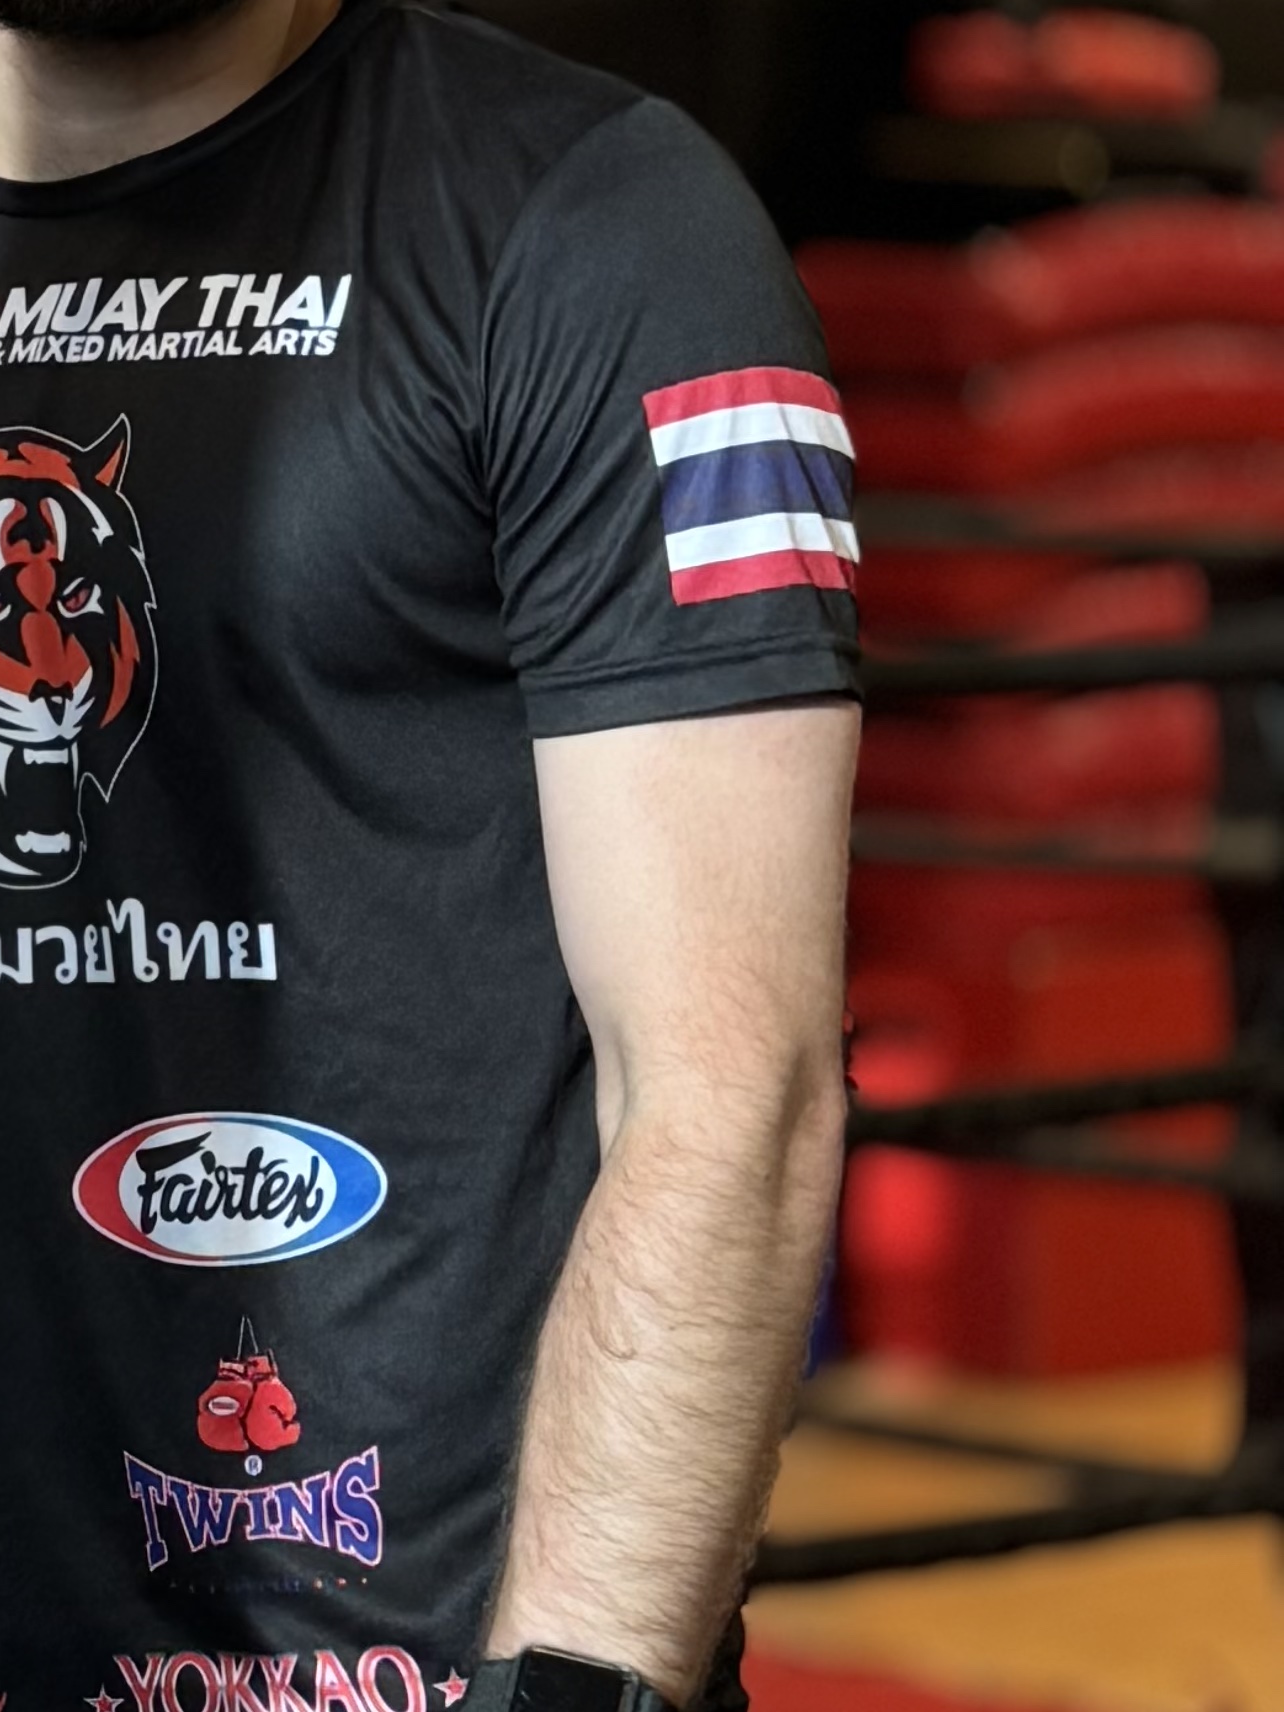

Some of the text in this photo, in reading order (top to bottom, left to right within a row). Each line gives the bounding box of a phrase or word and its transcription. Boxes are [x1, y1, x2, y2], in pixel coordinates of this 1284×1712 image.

[198, 273, 352, 328] THAI
[8, 335, 104, 364] MIXED
[107, 330, 243, 362] MARTIAL
[248, 328, 337, 357] ARTS
[135, 1131, 325, 1235] Fairtex
[123, 1445, 383, 1572] TWINS
